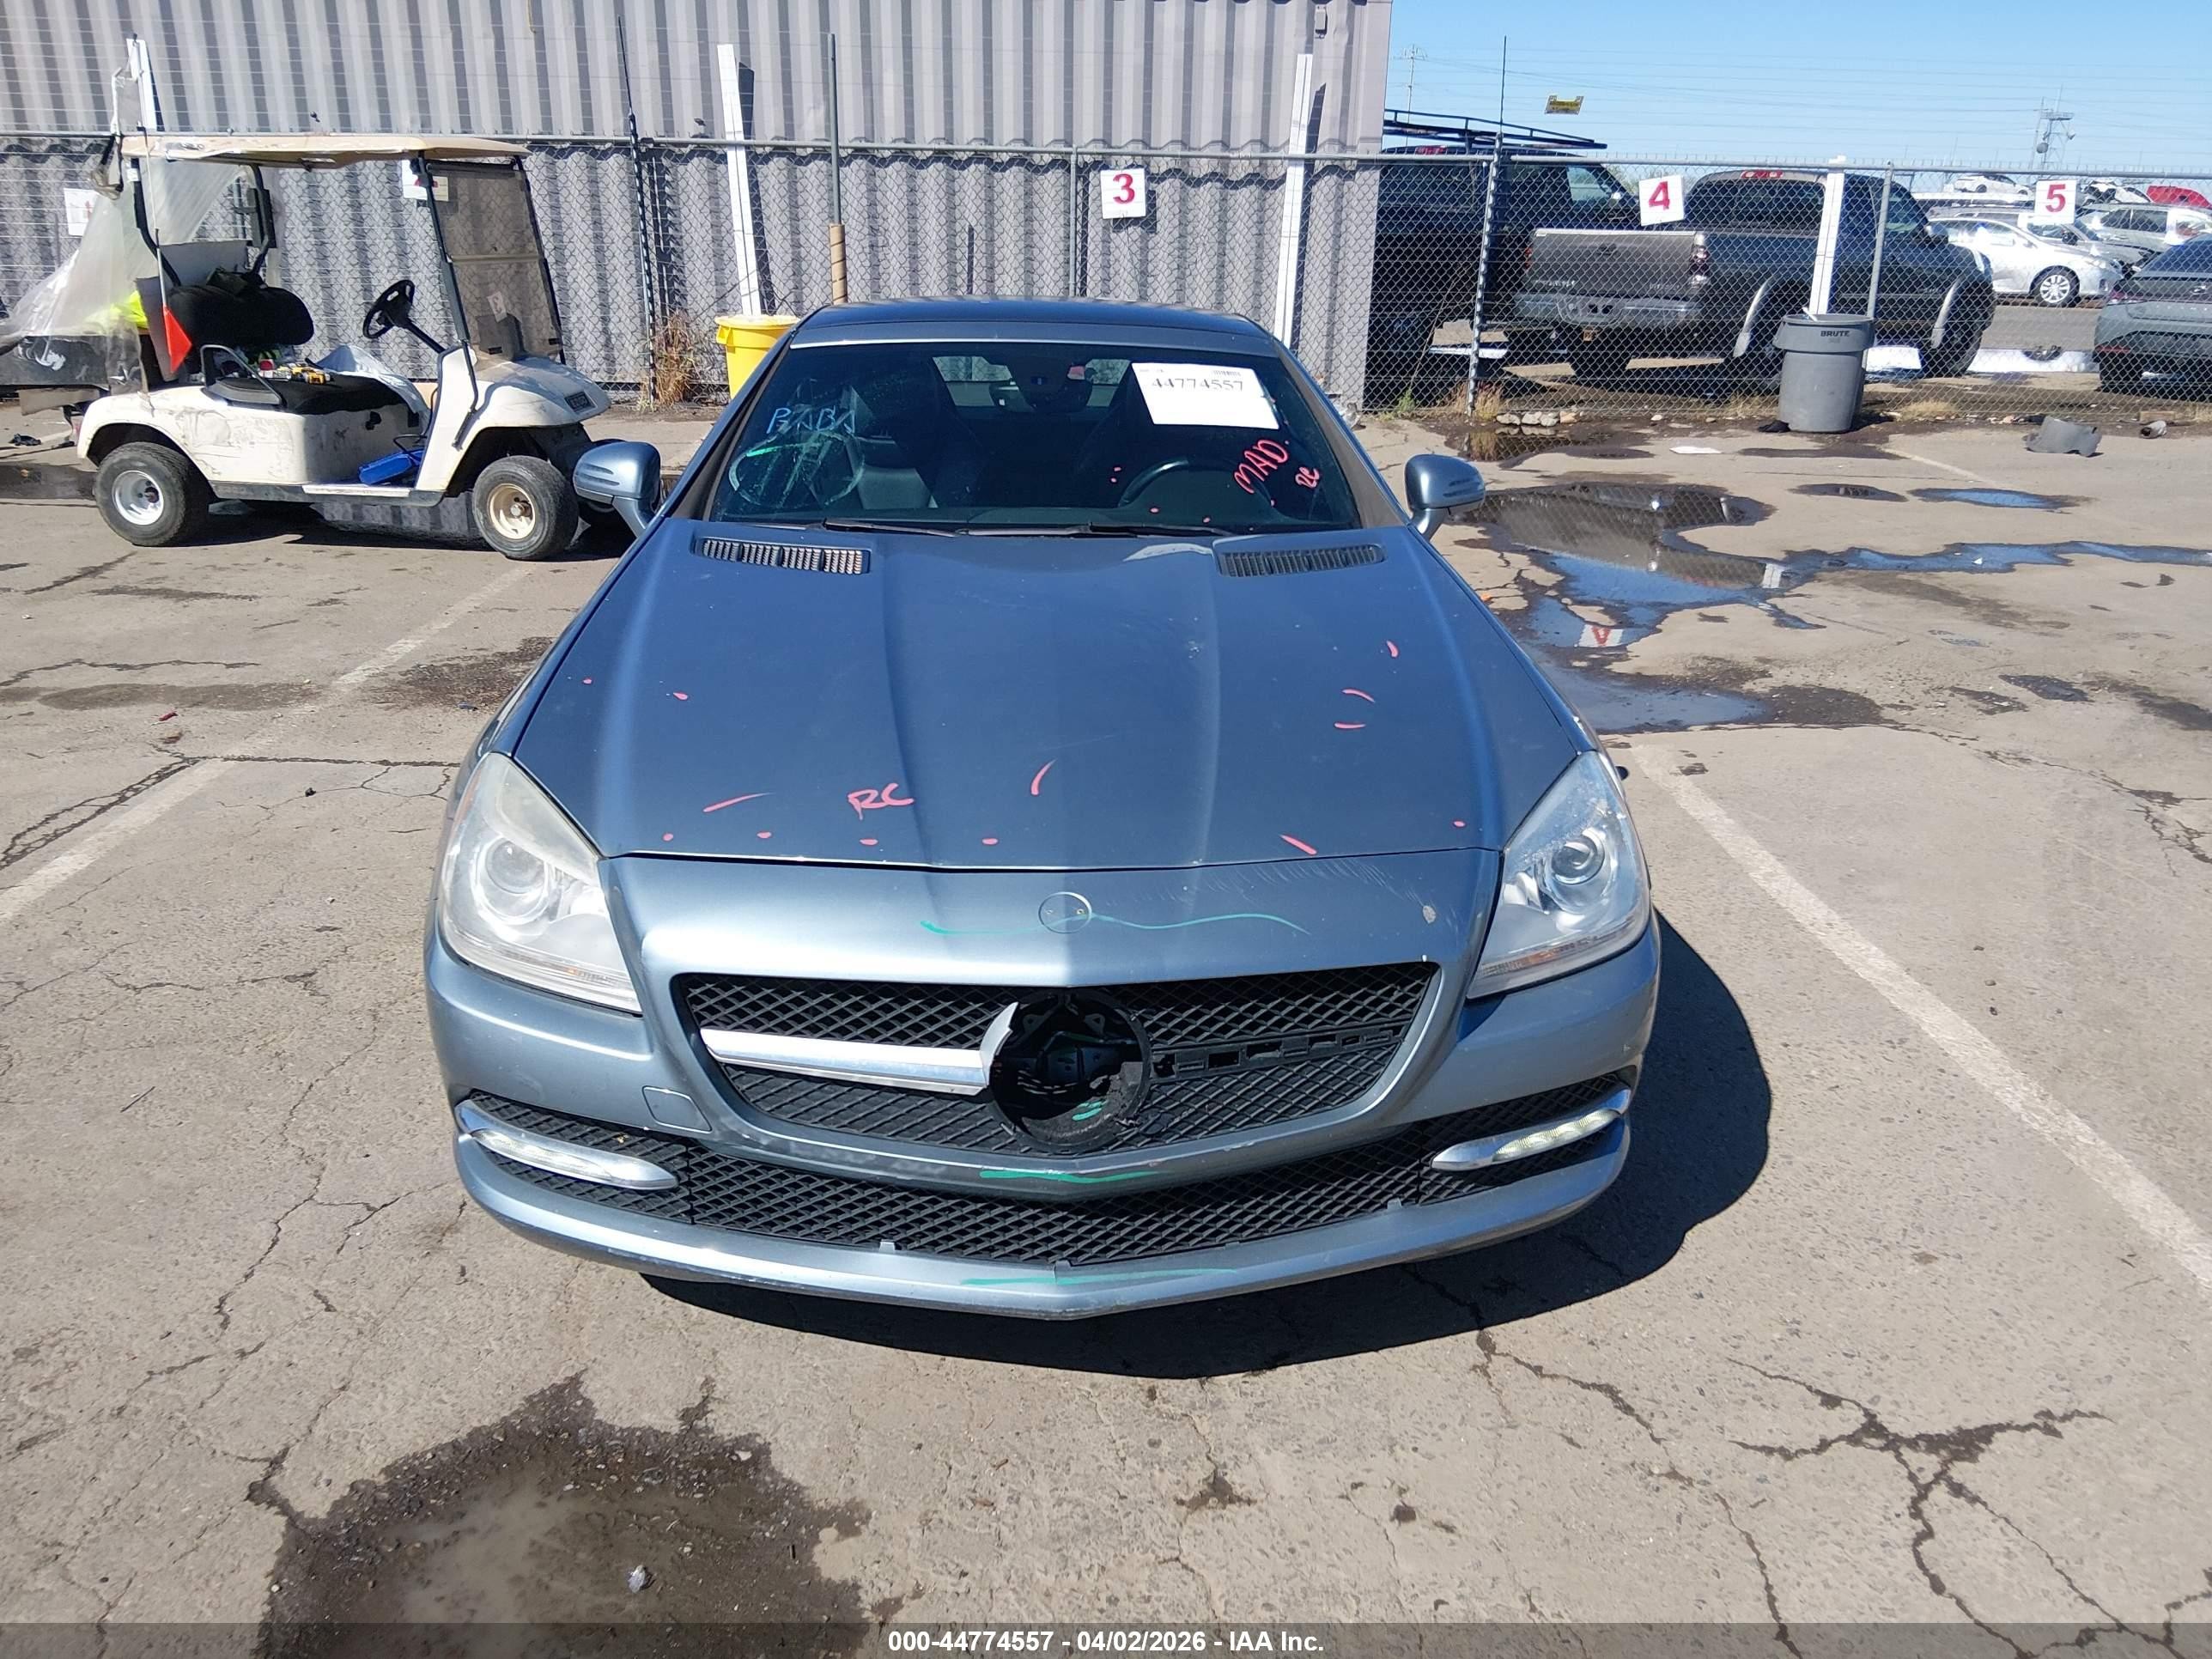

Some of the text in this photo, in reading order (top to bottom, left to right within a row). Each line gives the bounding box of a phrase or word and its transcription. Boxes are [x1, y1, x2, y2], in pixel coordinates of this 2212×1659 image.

[1113, 173, 1135, 204] 3
[1649, 181, 1670, 210] 4
[2045, 184, 2066, 213] 5
[1152, 378, 1243, 392] 44774557
[1234, 440, 1288, 494] MAD
[848, 782, 915, 820] RC
